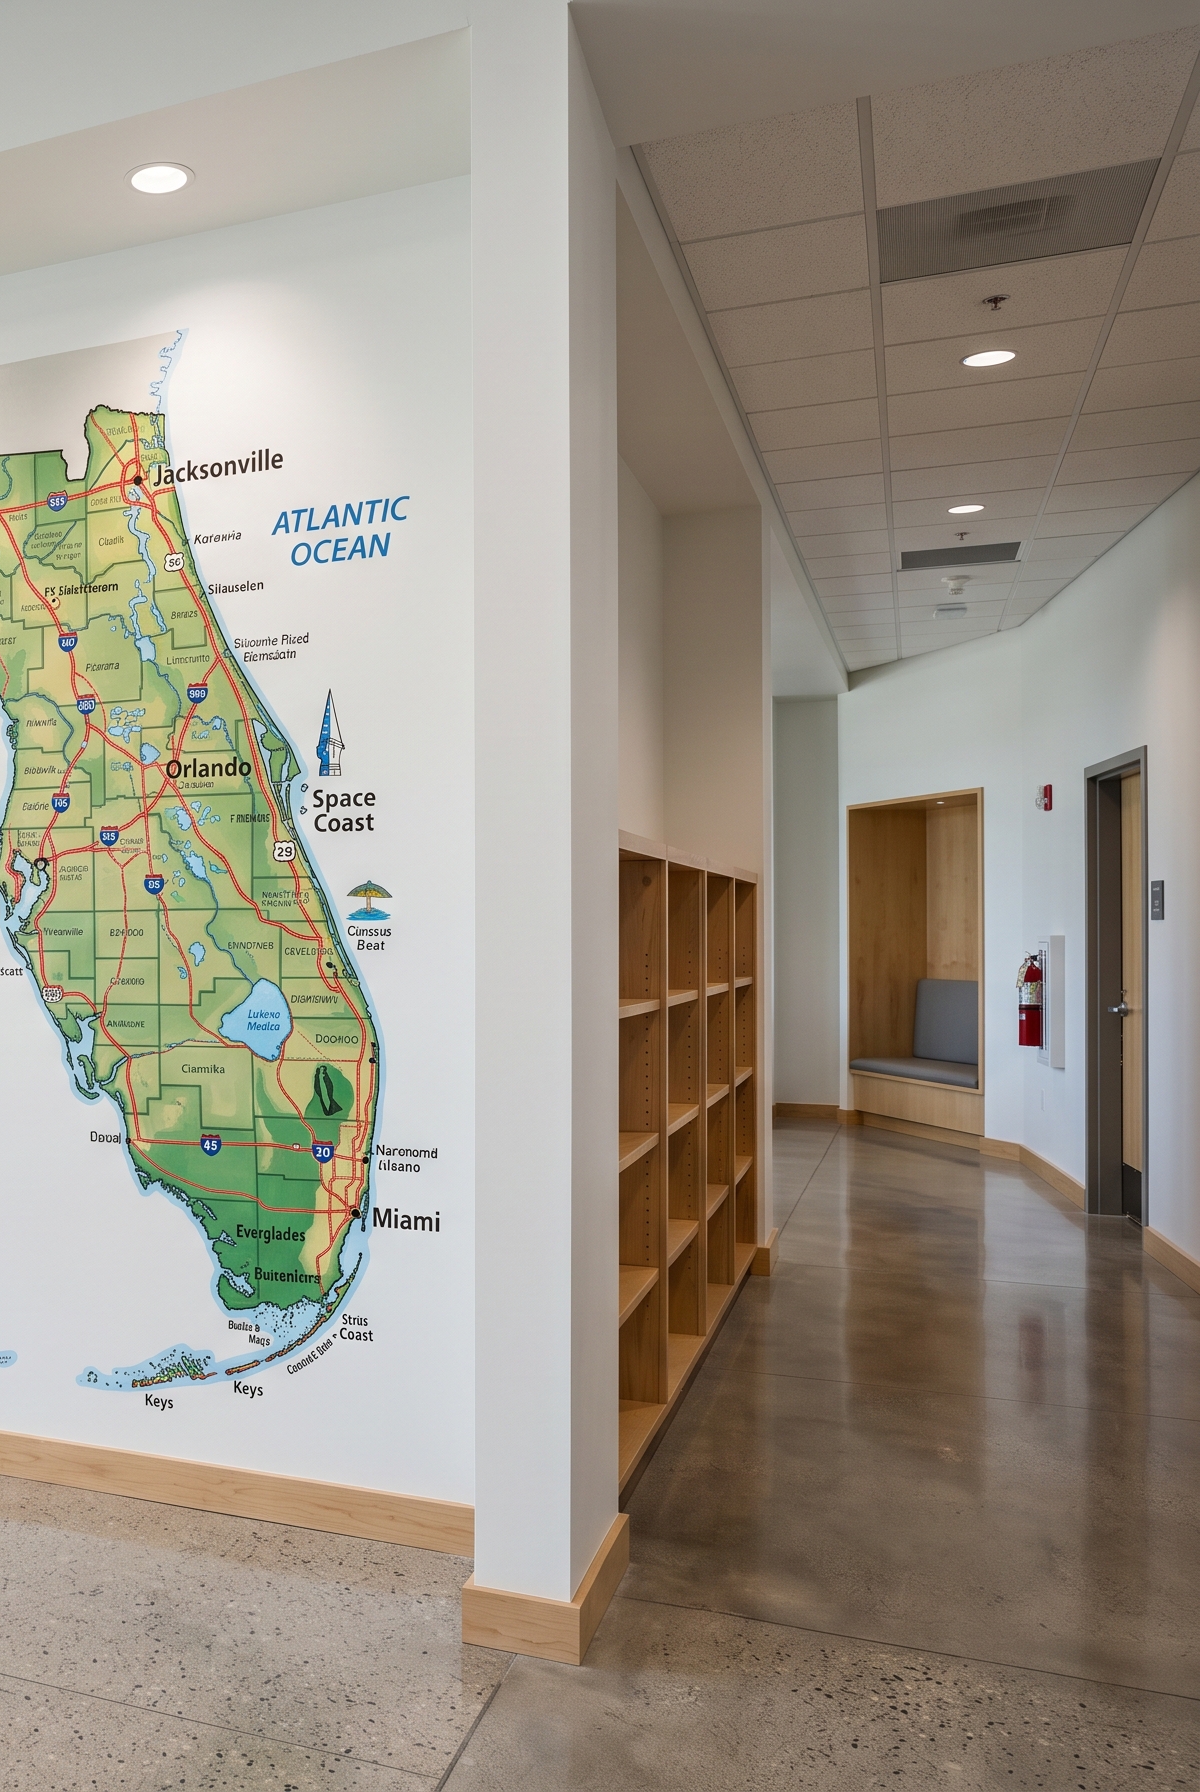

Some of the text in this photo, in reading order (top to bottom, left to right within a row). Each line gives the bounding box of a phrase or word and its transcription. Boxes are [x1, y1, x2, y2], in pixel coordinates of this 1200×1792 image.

[153, 448, 284, 487] Jacksonville
[271, 495, 410, 536] ATLANTIC
[290, 532, 391, 566] OCEAN
[166, 757, 252, 778] Orlando
[312, 789, 376, 813] Space
[314, 813, 375, 832] Coast
[277, 846, 293, 857] 29
[357, 940, 385, 951] Beat
[204, 1141, 217, 1150] 45
[373, 1207, 440, 1232] Miami
[236, 1224, 306, 1243] Everglades
[340, 1328, 374, 1342] Coast
[234, 1381, 264, 1399] Keys
[145, 1394, 174, 1411] Keys
